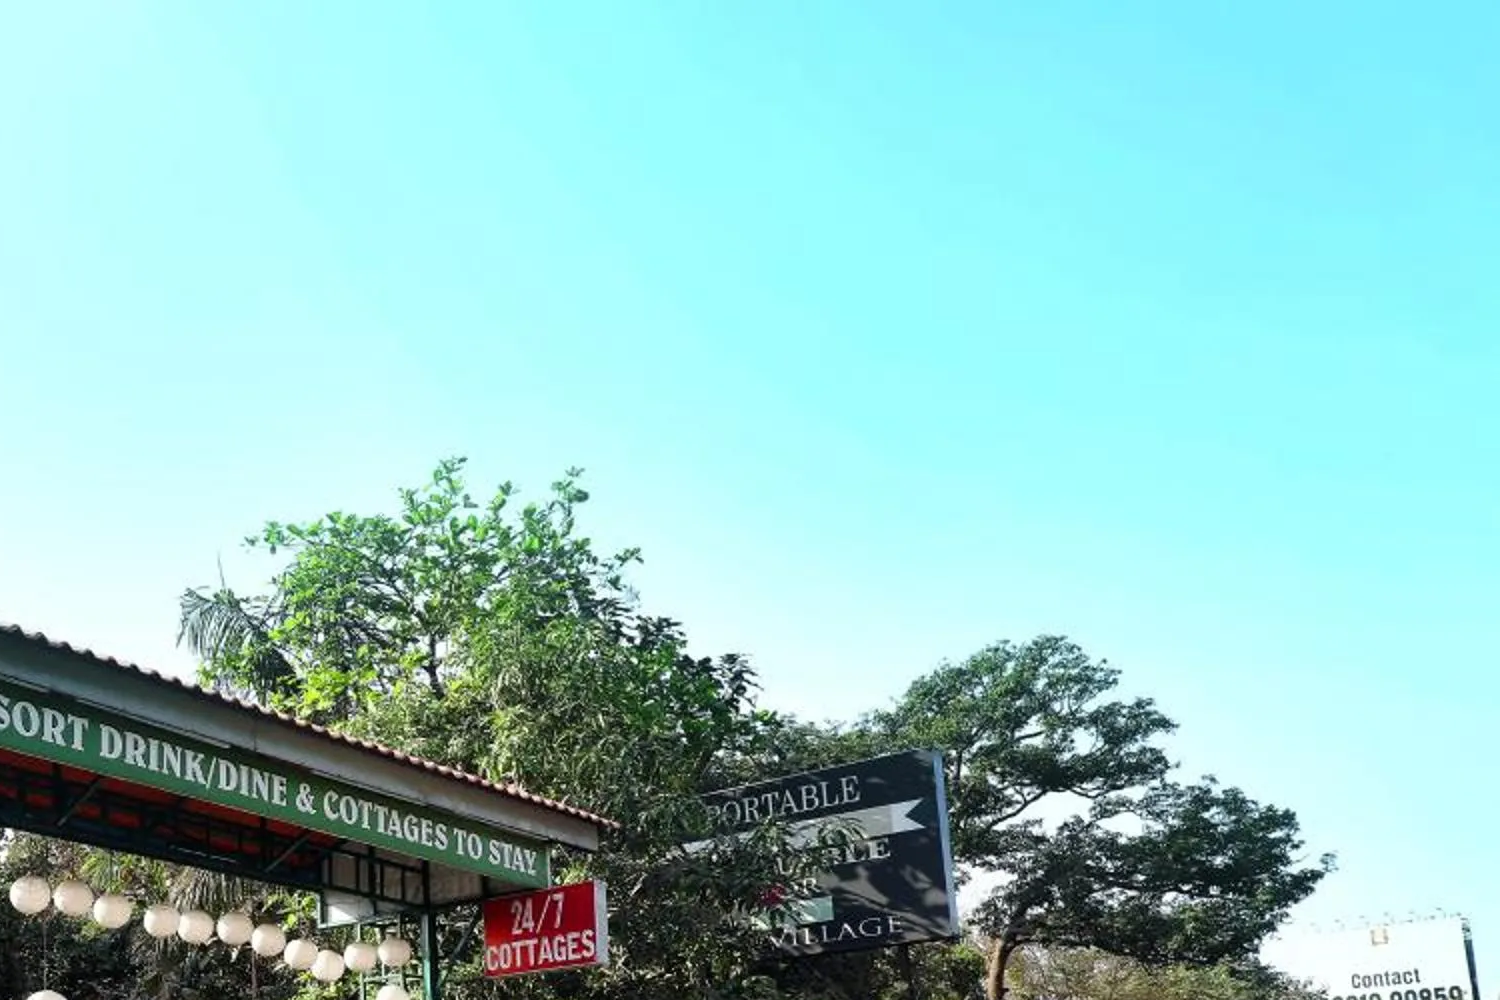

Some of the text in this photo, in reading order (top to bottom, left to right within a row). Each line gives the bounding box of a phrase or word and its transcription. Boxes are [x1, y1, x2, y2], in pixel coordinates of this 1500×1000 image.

[706, 775, 861, 826] PORTABLE
[295, 783, 317, 816] &
[323, 790, 449, 852] COTTAGES
[452, 828, 483, 860] TO
[488, 838, 537, 876] STAY
[510, 891, 565, 936] 24/7
[769, 914, 904, 948] VILLAGE
[485, 929, 595, 971] COTTAGES
[1351, 968, 1421, 989] Contact
